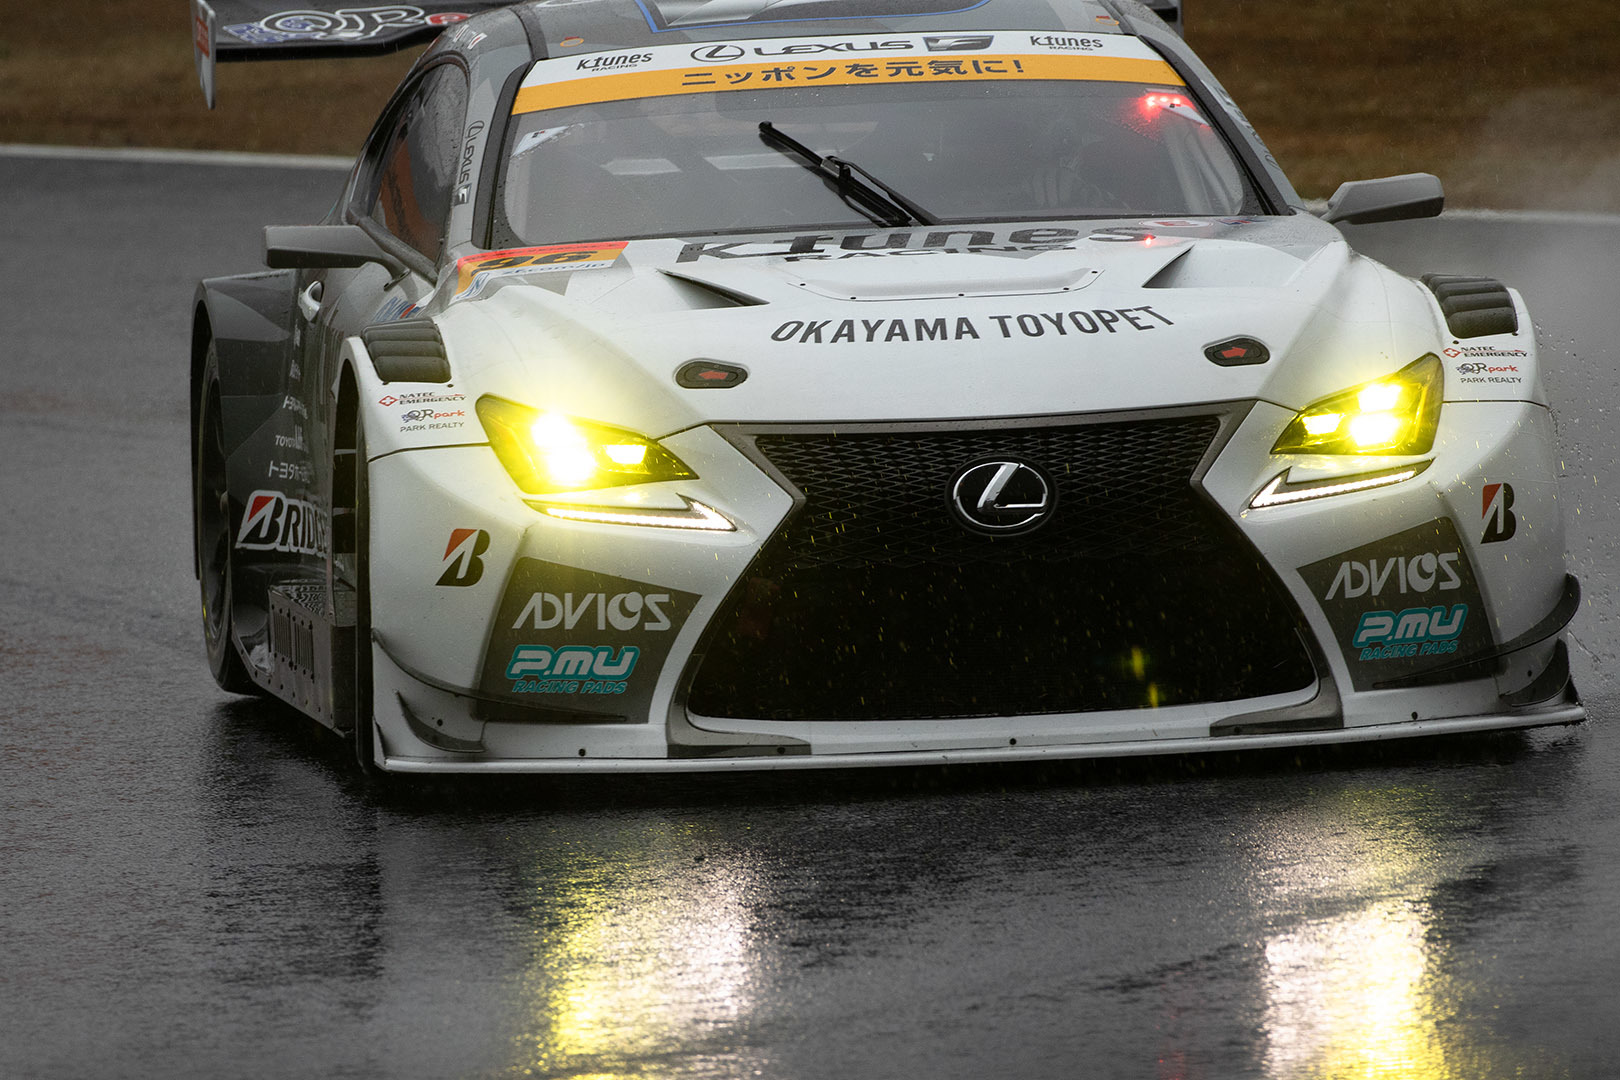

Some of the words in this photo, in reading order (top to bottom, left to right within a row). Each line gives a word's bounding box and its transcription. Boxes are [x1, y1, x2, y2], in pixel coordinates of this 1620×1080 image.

[754, 40, 914, 56] LEXUS
[458, 137, 477, 184] LEXUS
[770, 316, 980, 344] OKAYAMA
[988, 305, 1175, 338] TOYOPET
[400, 391, 435, 399] NATEC
[400, 396, 467, 405] EMERGENCY
[400, 424, 426, 432] PARK
[429, 421, 465, 429] REALTY
[1359, 641, 1417, 661] RACING
[1419, 640, 1459, 656] PADS
[512, 680, 577, 694] RACING
[580, 680, 628, 694] PADS
